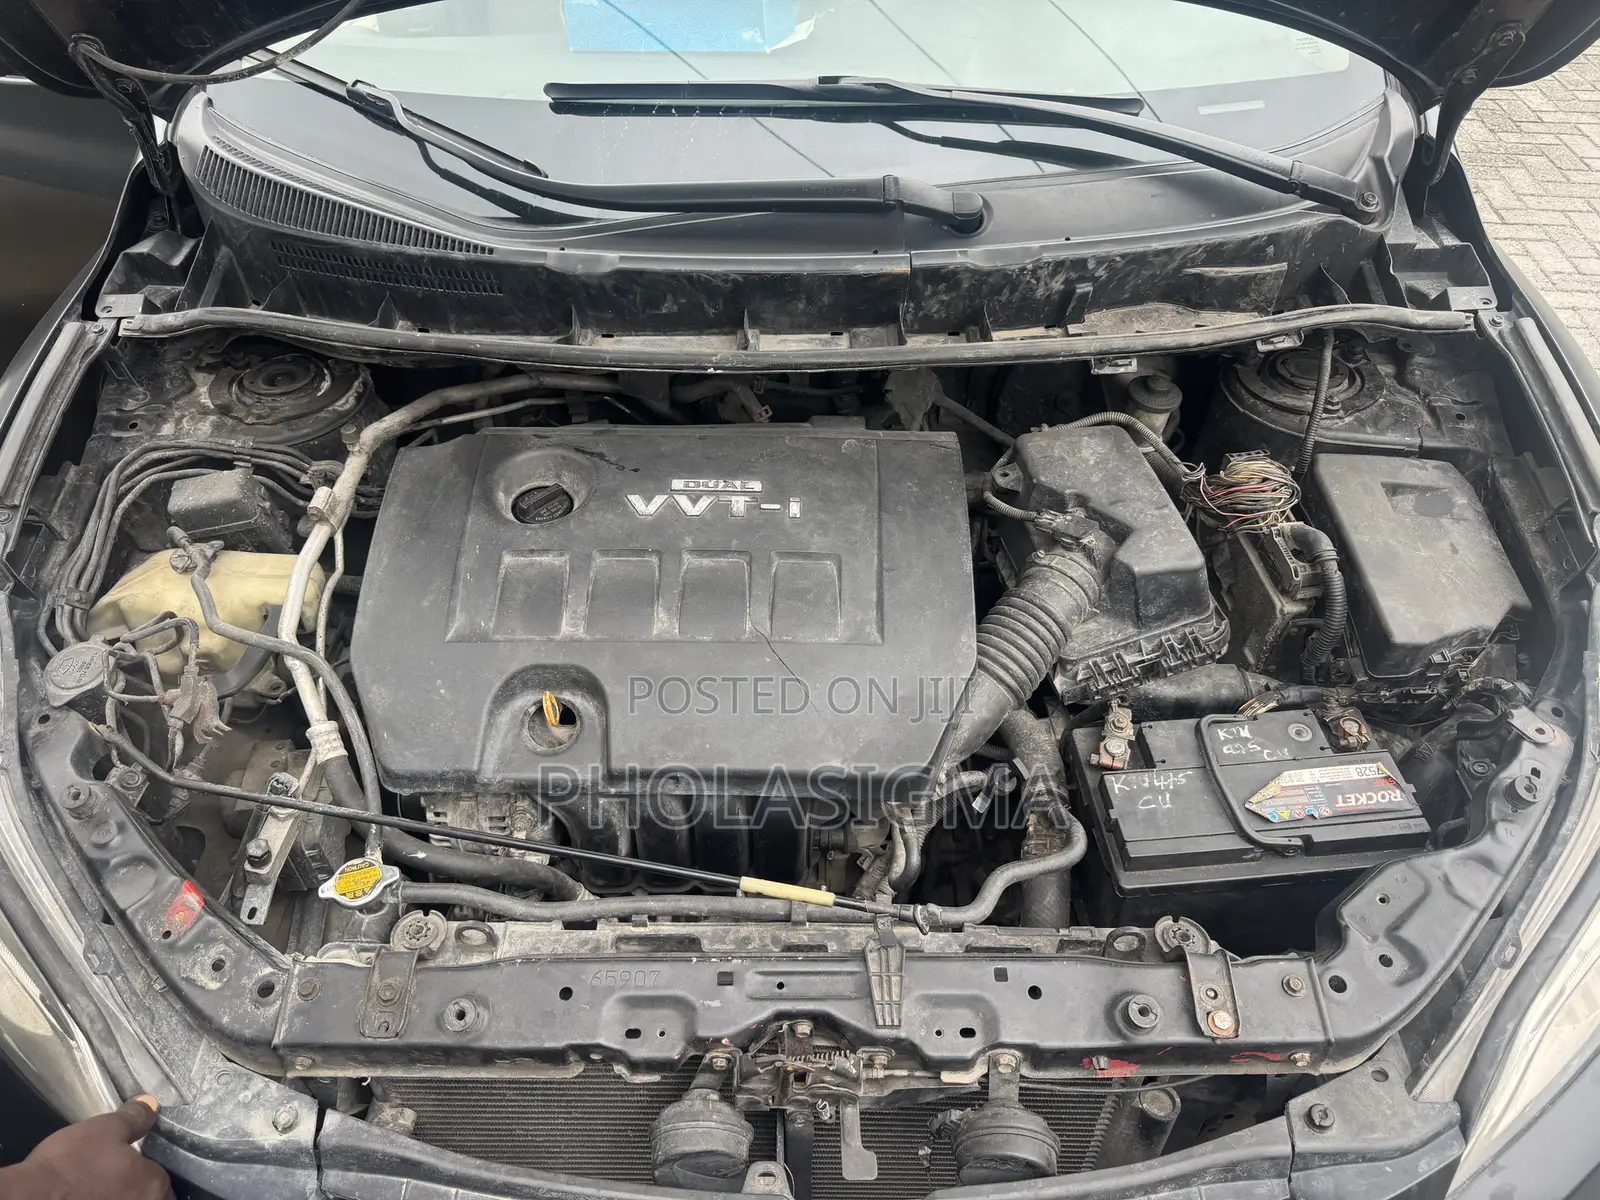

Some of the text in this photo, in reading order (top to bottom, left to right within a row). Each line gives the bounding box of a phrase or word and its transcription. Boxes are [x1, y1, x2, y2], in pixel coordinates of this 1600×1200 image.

[682, 480, 756, 490] DUAL
[1335, 789, 1404, 808] ROCKET
[590, 969, 661, 988] 65907
